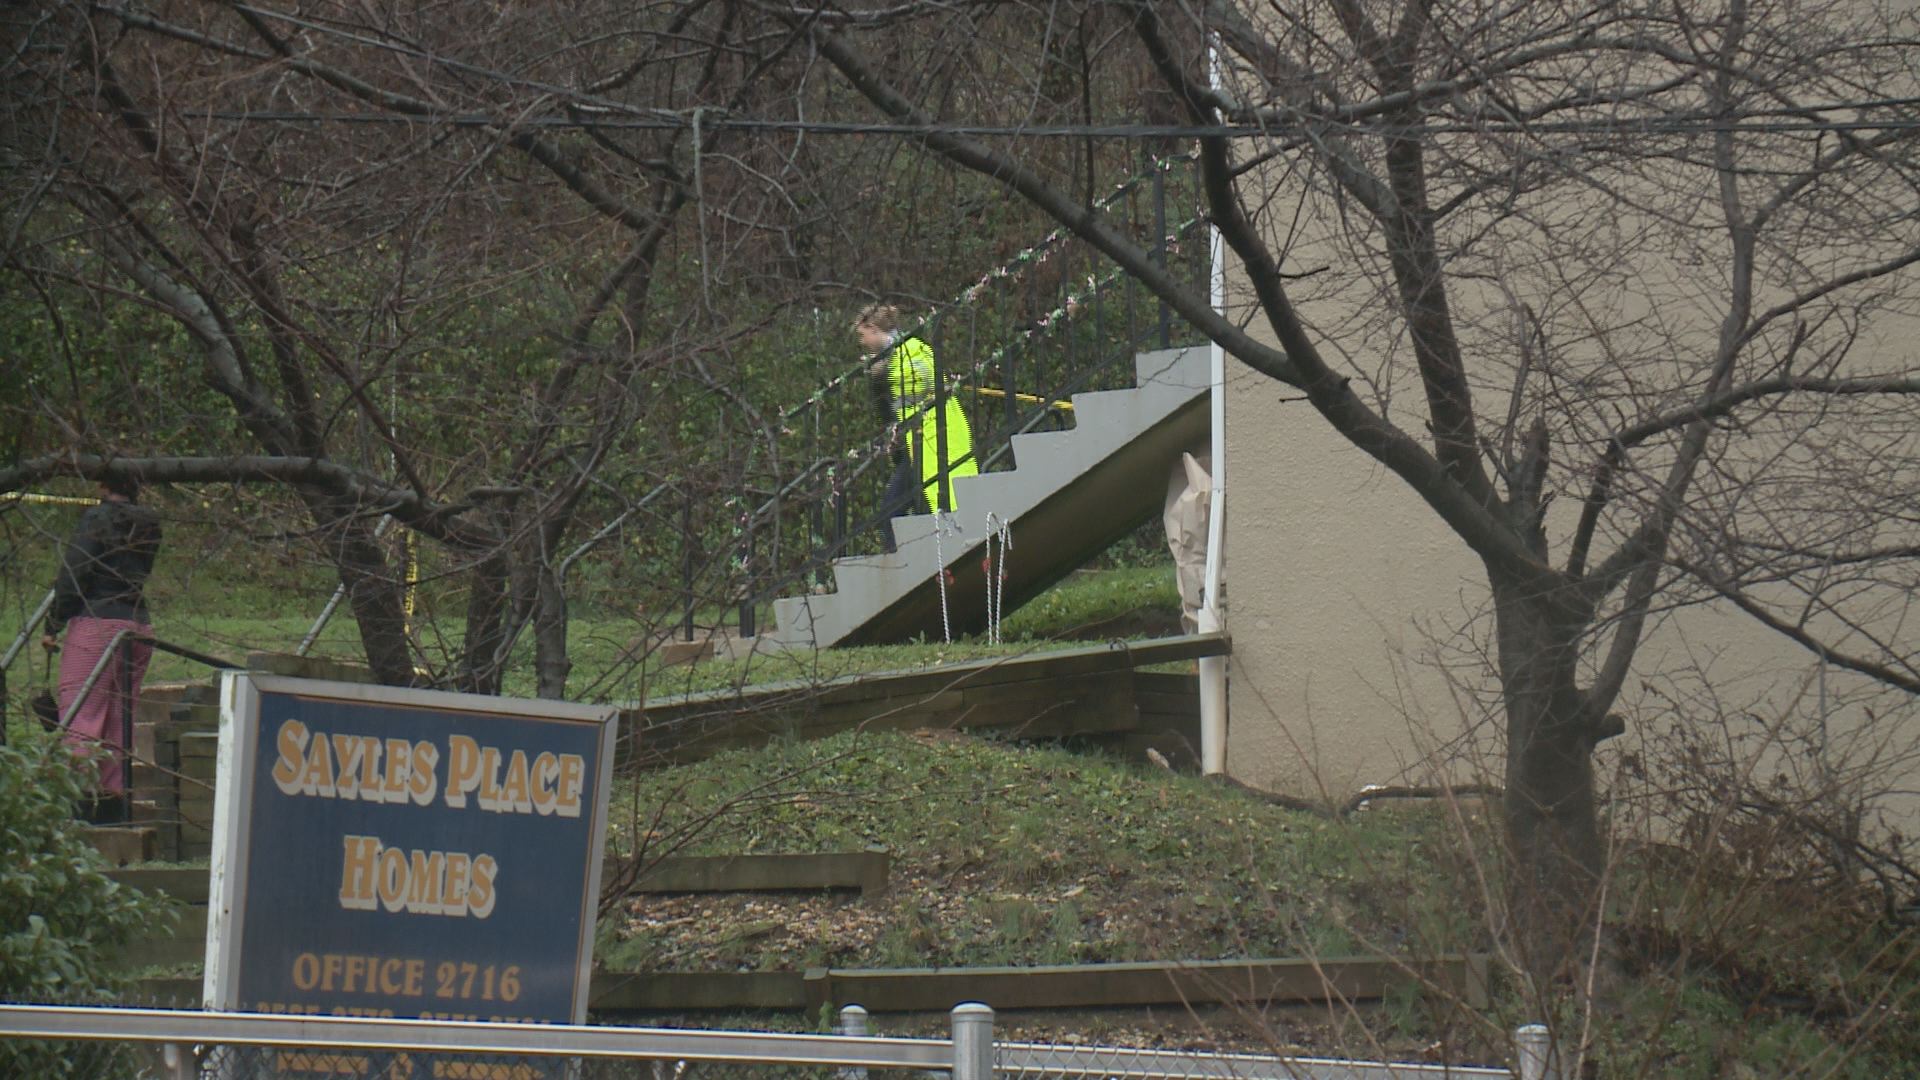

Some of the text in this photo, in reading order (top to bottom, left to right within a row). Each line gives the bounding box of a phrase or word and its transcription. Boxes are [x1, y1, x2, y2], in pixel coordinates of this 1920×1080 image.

[272, 719, 585, 818] SAYLES PLACE
[339, 834, 498, 920] HOMES
[292, 952, 521, 1002] OFFICE 2716
